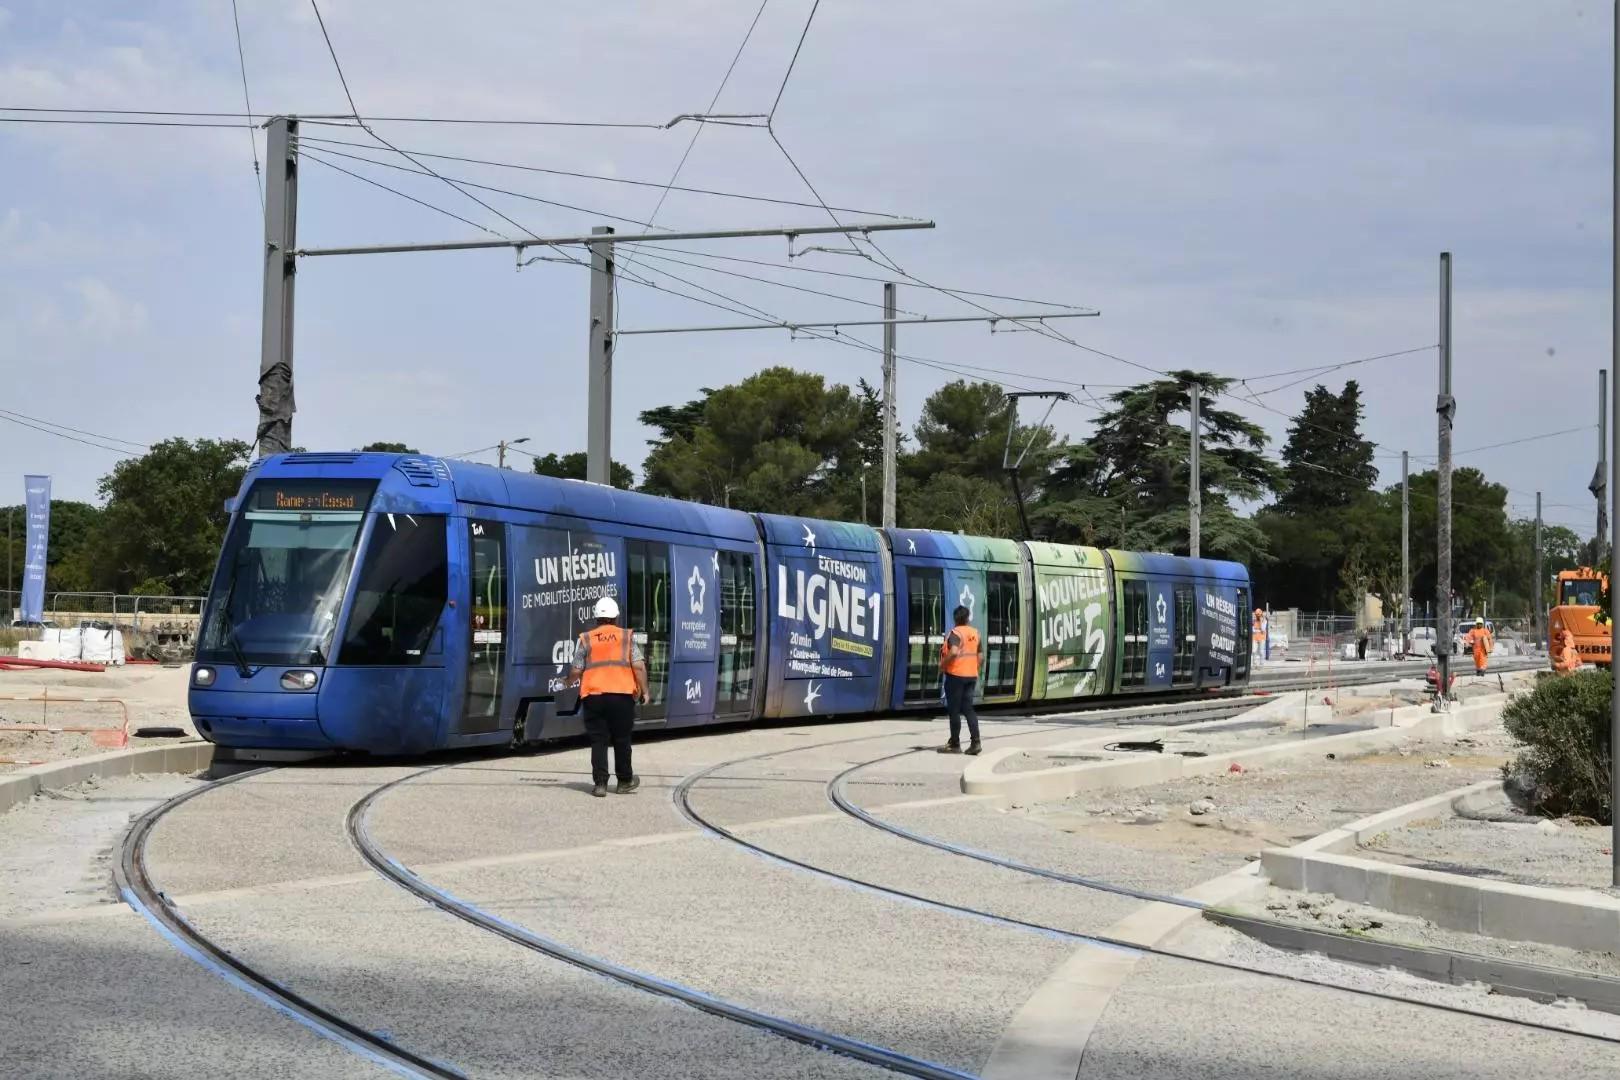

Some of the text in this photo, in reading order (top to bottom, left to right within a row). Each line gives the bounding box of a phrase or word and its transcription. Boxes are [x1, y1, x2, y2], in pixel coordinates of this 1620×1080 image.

[534, 547, 617, 586] UN RÉSEAU
[819, 555, 866, 583] EXTENSION
[522, 582, 618, 609] DE MOBILITÉS DÉCARBONÉES
[778, 565, 881, 641] LIGNE 1
[1039, 569, 1107, 613] NOUVELLE
[578, 606, 592, 624] QUI
[789, 631, 812, 648] 20 min
[1041, 602, 1106, 696] LIGNE 5
